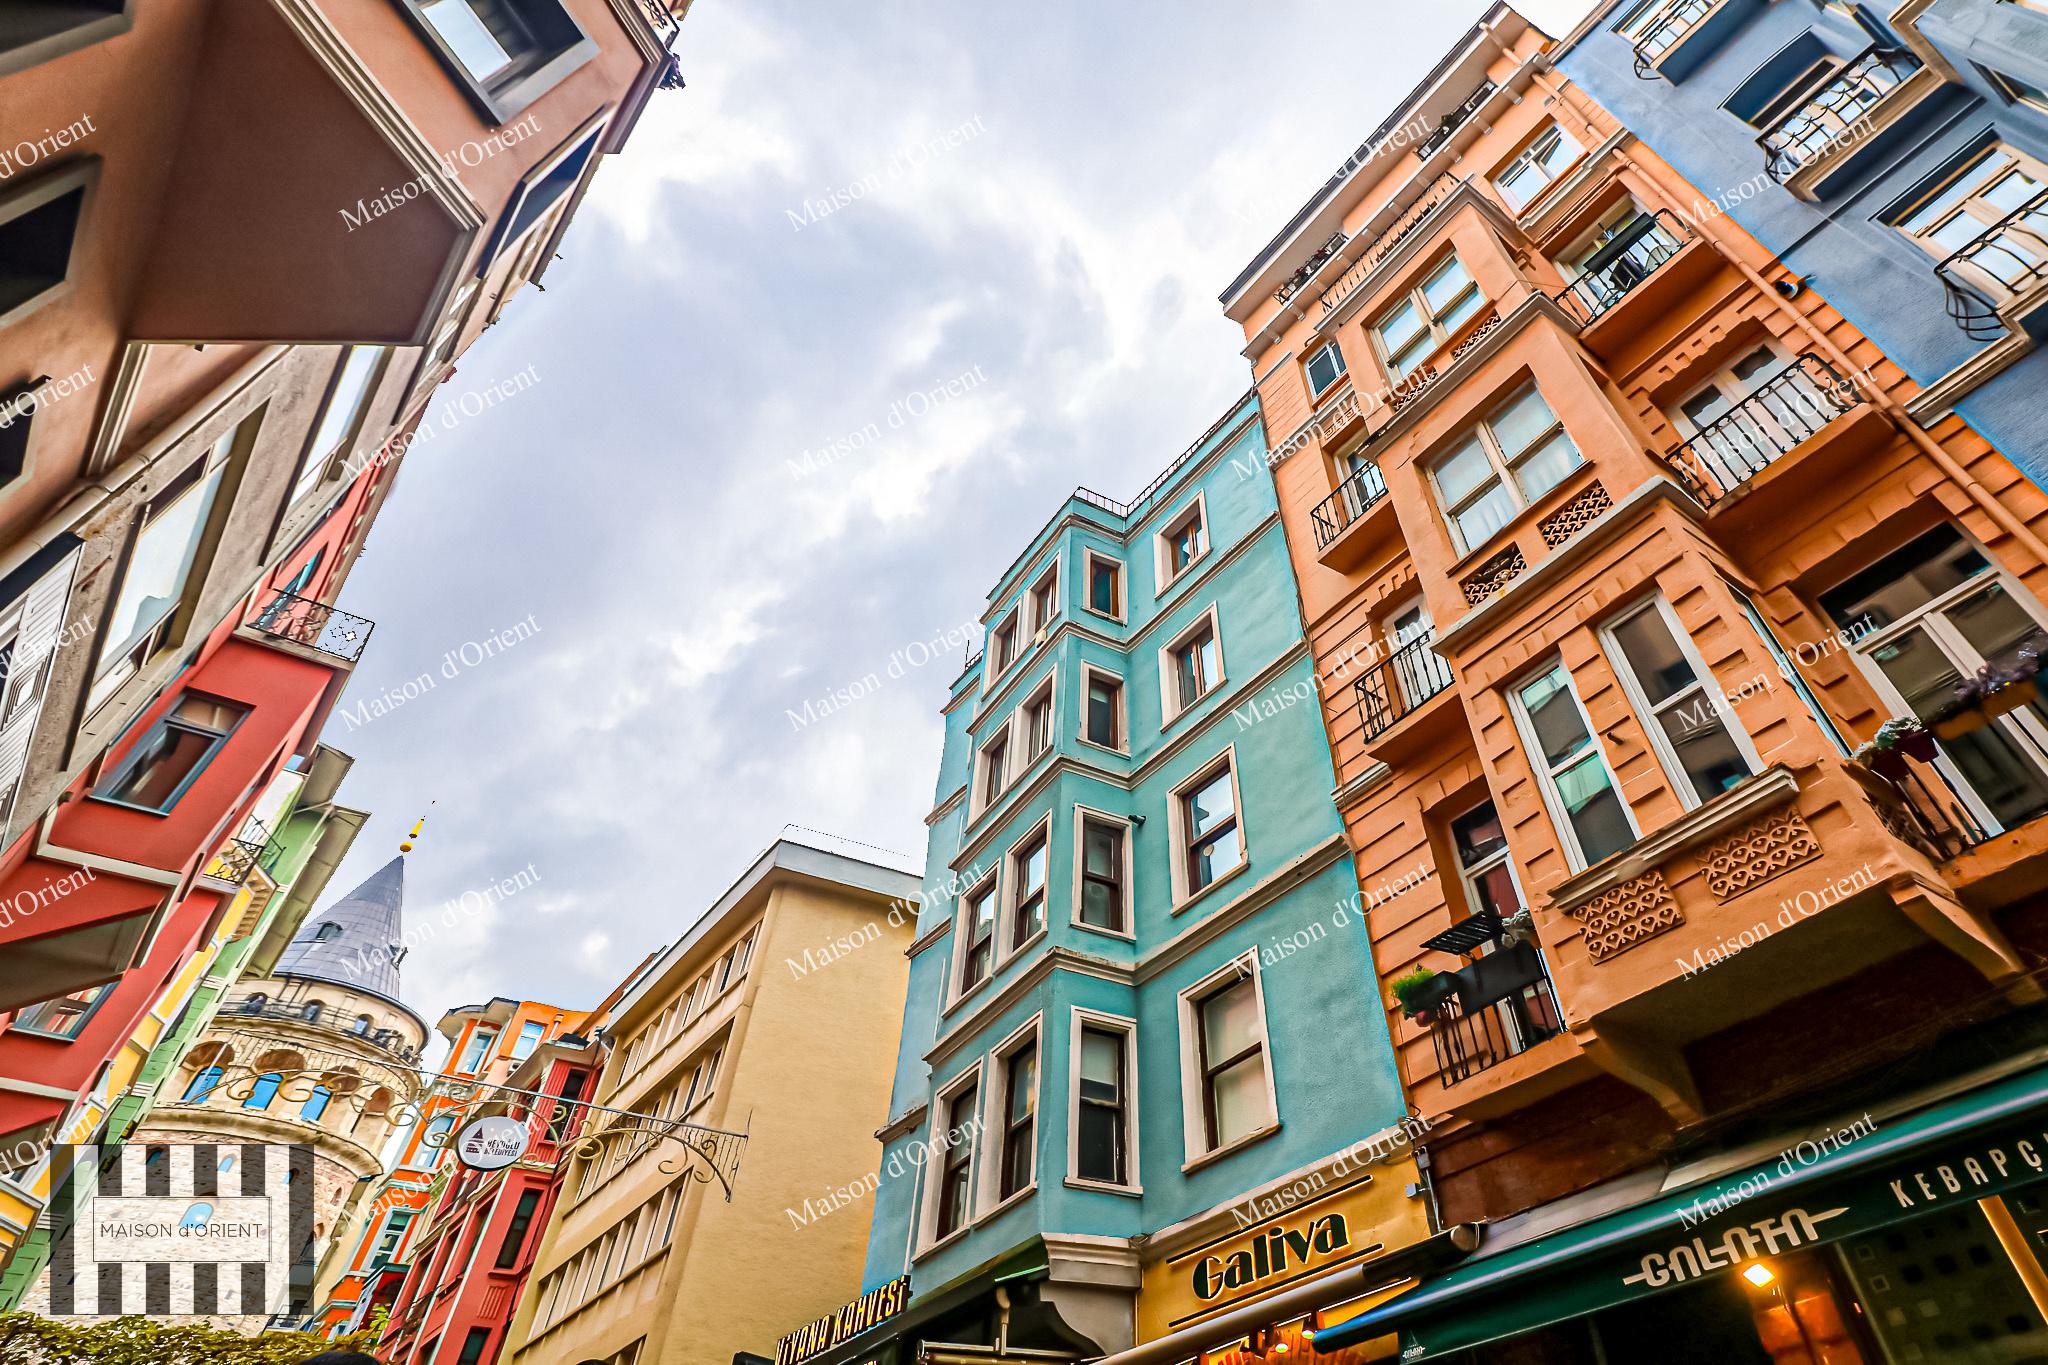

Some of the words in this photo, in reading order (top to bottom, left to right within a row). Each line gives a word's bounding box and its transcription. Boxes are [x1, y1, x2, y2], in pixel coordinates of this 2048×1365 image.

[1192, 1213, 1351, 1300] Galiva
[1640, 1207, 1819, 1287] GALATA
[1889, 1132, 2048, 1209] KEBAPÇ
